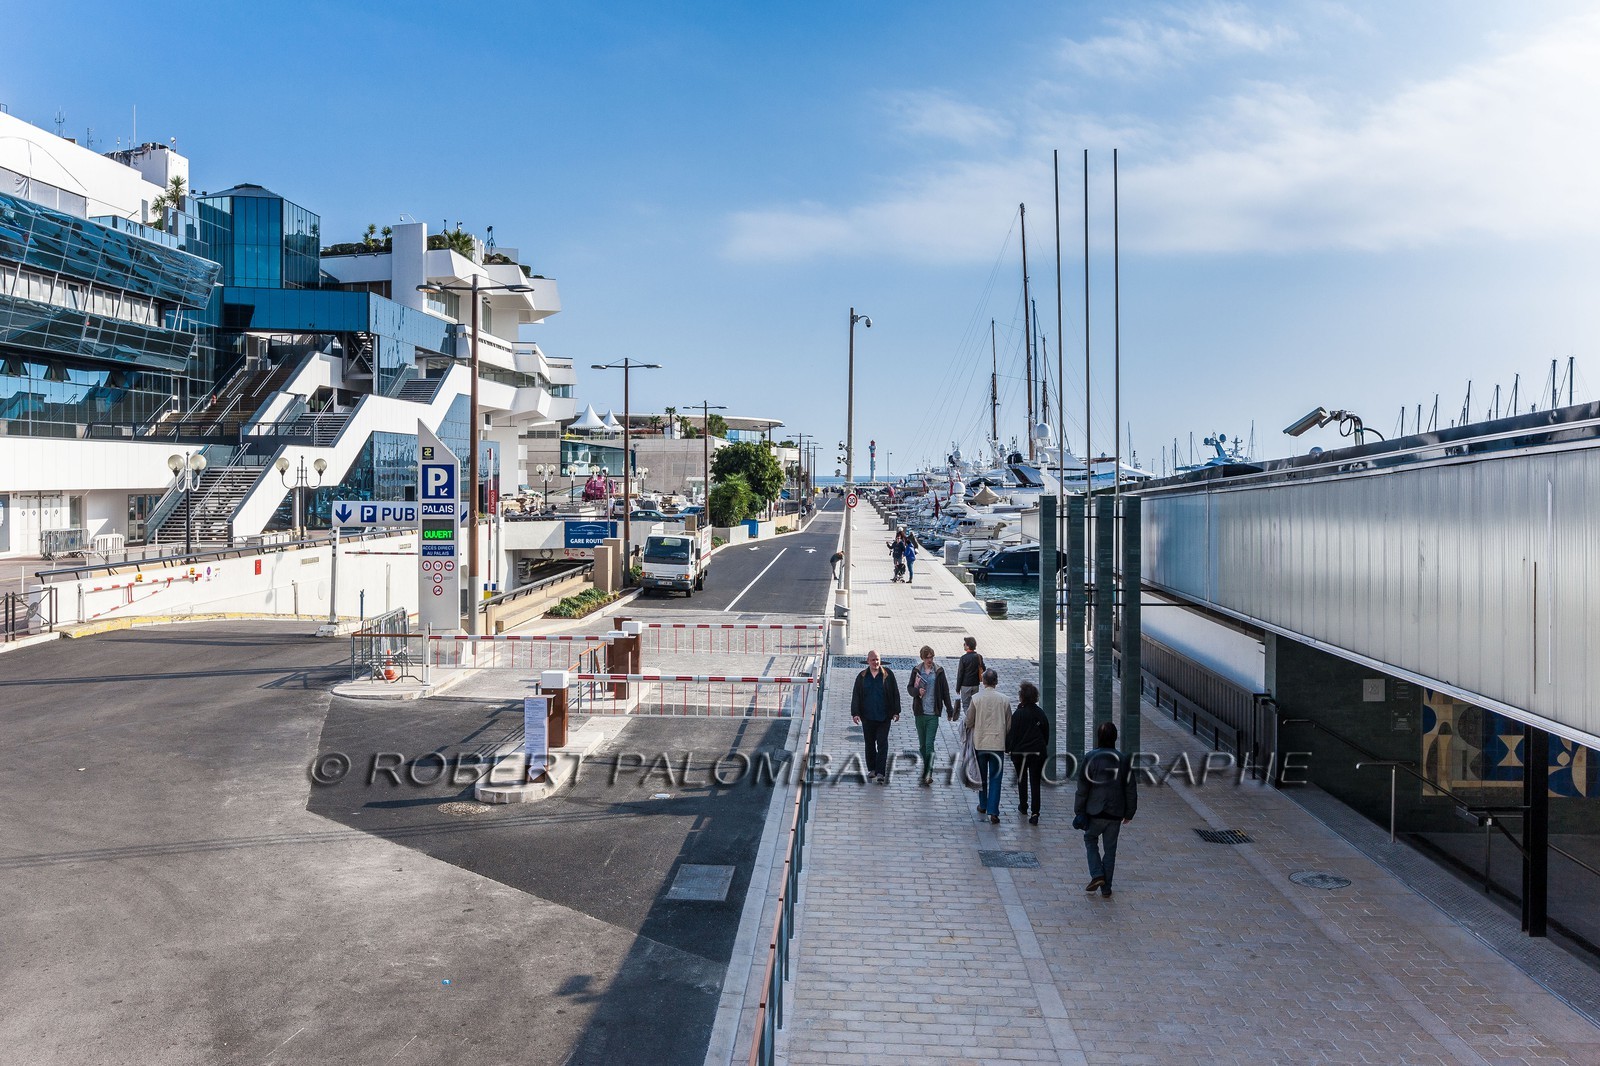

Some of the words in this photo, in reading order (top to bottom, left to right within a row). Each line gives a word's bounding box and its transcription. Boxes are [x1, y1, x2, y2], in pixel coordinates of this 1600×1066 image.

[427, 467, 449, 496] P
[363, 507, 374, 521] P
[382, 507, 418, 521] PUB
[422, 505, 454, 513] PALAIS
[424, 530, 453, 539] OUVERT
